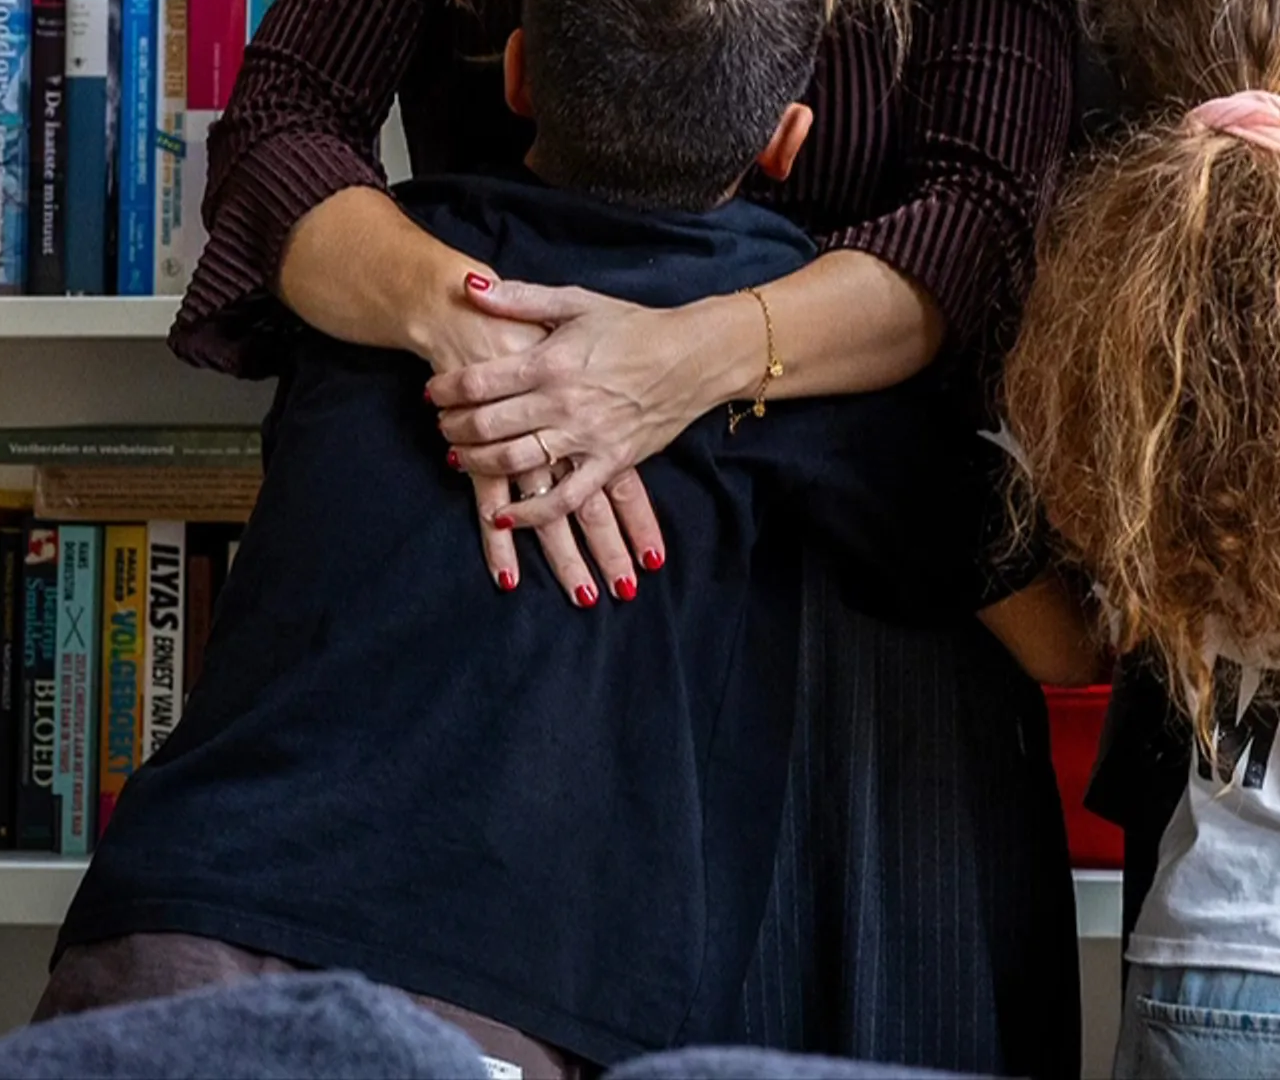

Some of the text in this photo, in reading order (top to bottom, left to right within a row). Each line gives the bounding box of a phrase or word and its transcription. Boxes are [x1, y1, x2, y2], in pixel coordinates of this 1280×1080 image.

[42, 90, 61, 255] De laatste minuut
[150, 543, 180, 631] ILYAS
[107, 611, 136, 780] VOLGEBOEKT
[153, 635, 174, 690] ERNEST
[31, 679, 56, 787] BLOED
